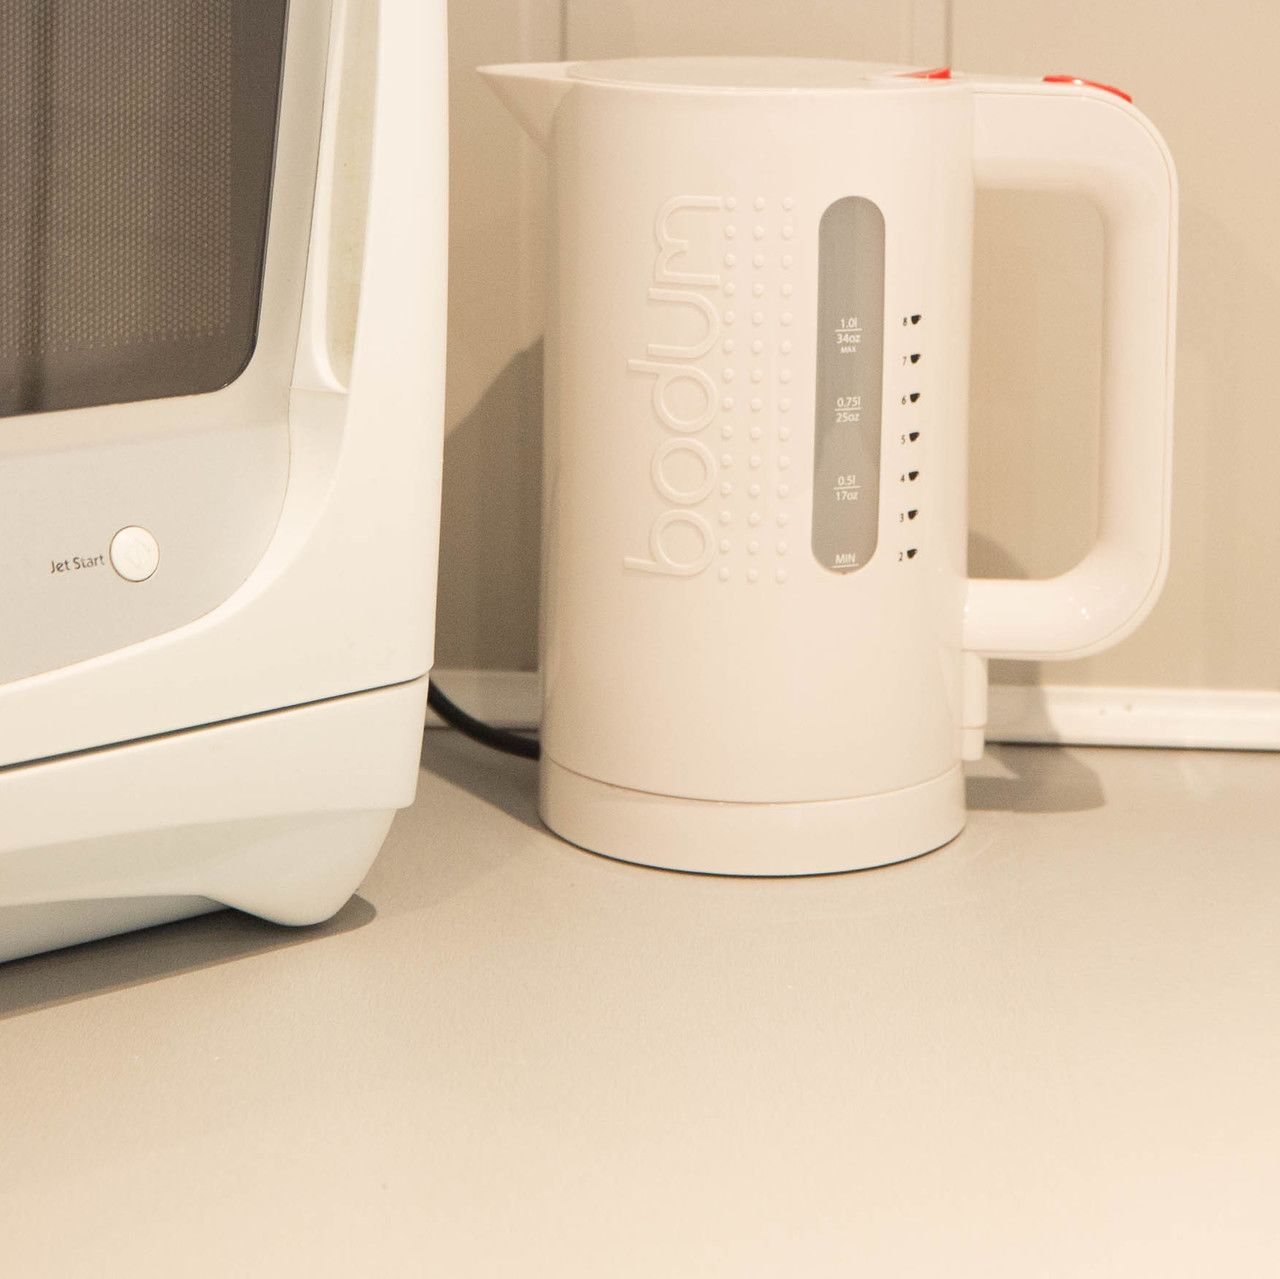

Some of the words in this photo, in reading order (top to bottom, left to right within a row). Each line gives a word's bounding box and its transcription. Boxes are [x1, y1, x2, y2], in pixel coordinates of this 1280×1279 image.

[836, 333, 861, 344] 34oz
[623, 194, 722, 578] bodum
[836, 411, 860, 423] 25oz
[835, 491, 859, 501] 17oz
[50, 560, 71, 574] Jet
[72, 554, 105, 570] Start
[835, 553, 856, 564] MIN
